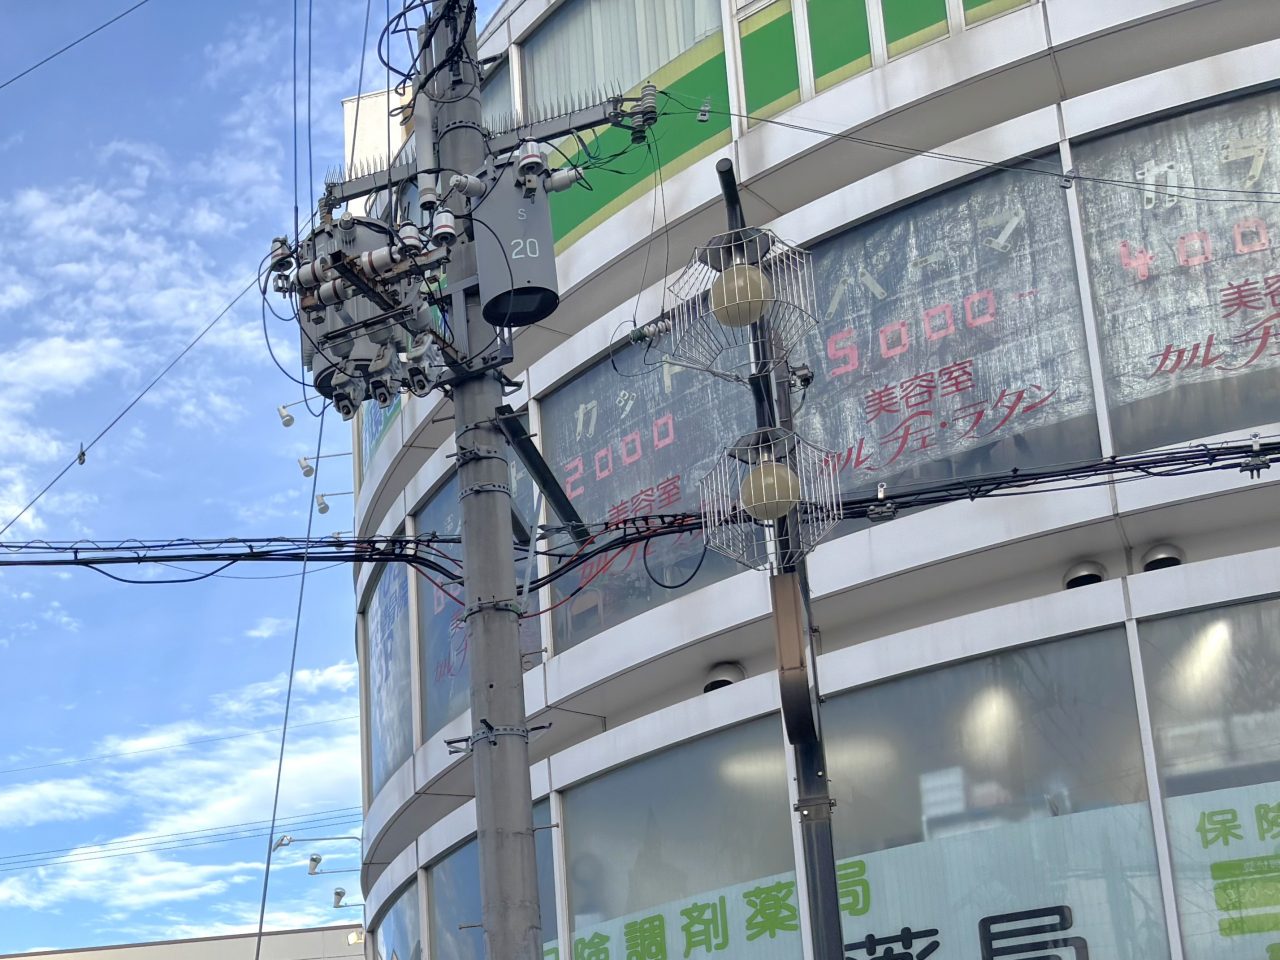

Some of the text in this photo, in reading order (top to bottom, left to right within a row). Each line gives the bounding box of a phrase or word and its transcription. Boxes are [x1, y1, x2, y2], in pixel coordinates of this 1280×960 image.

[517, 208, 527, 220] S
[511, 238, 539, 259] 20
[865, 360, 976, 424] 美容室
[564, 413, 675, 501] 2000
[607, 475, 682, 526] 美容室
